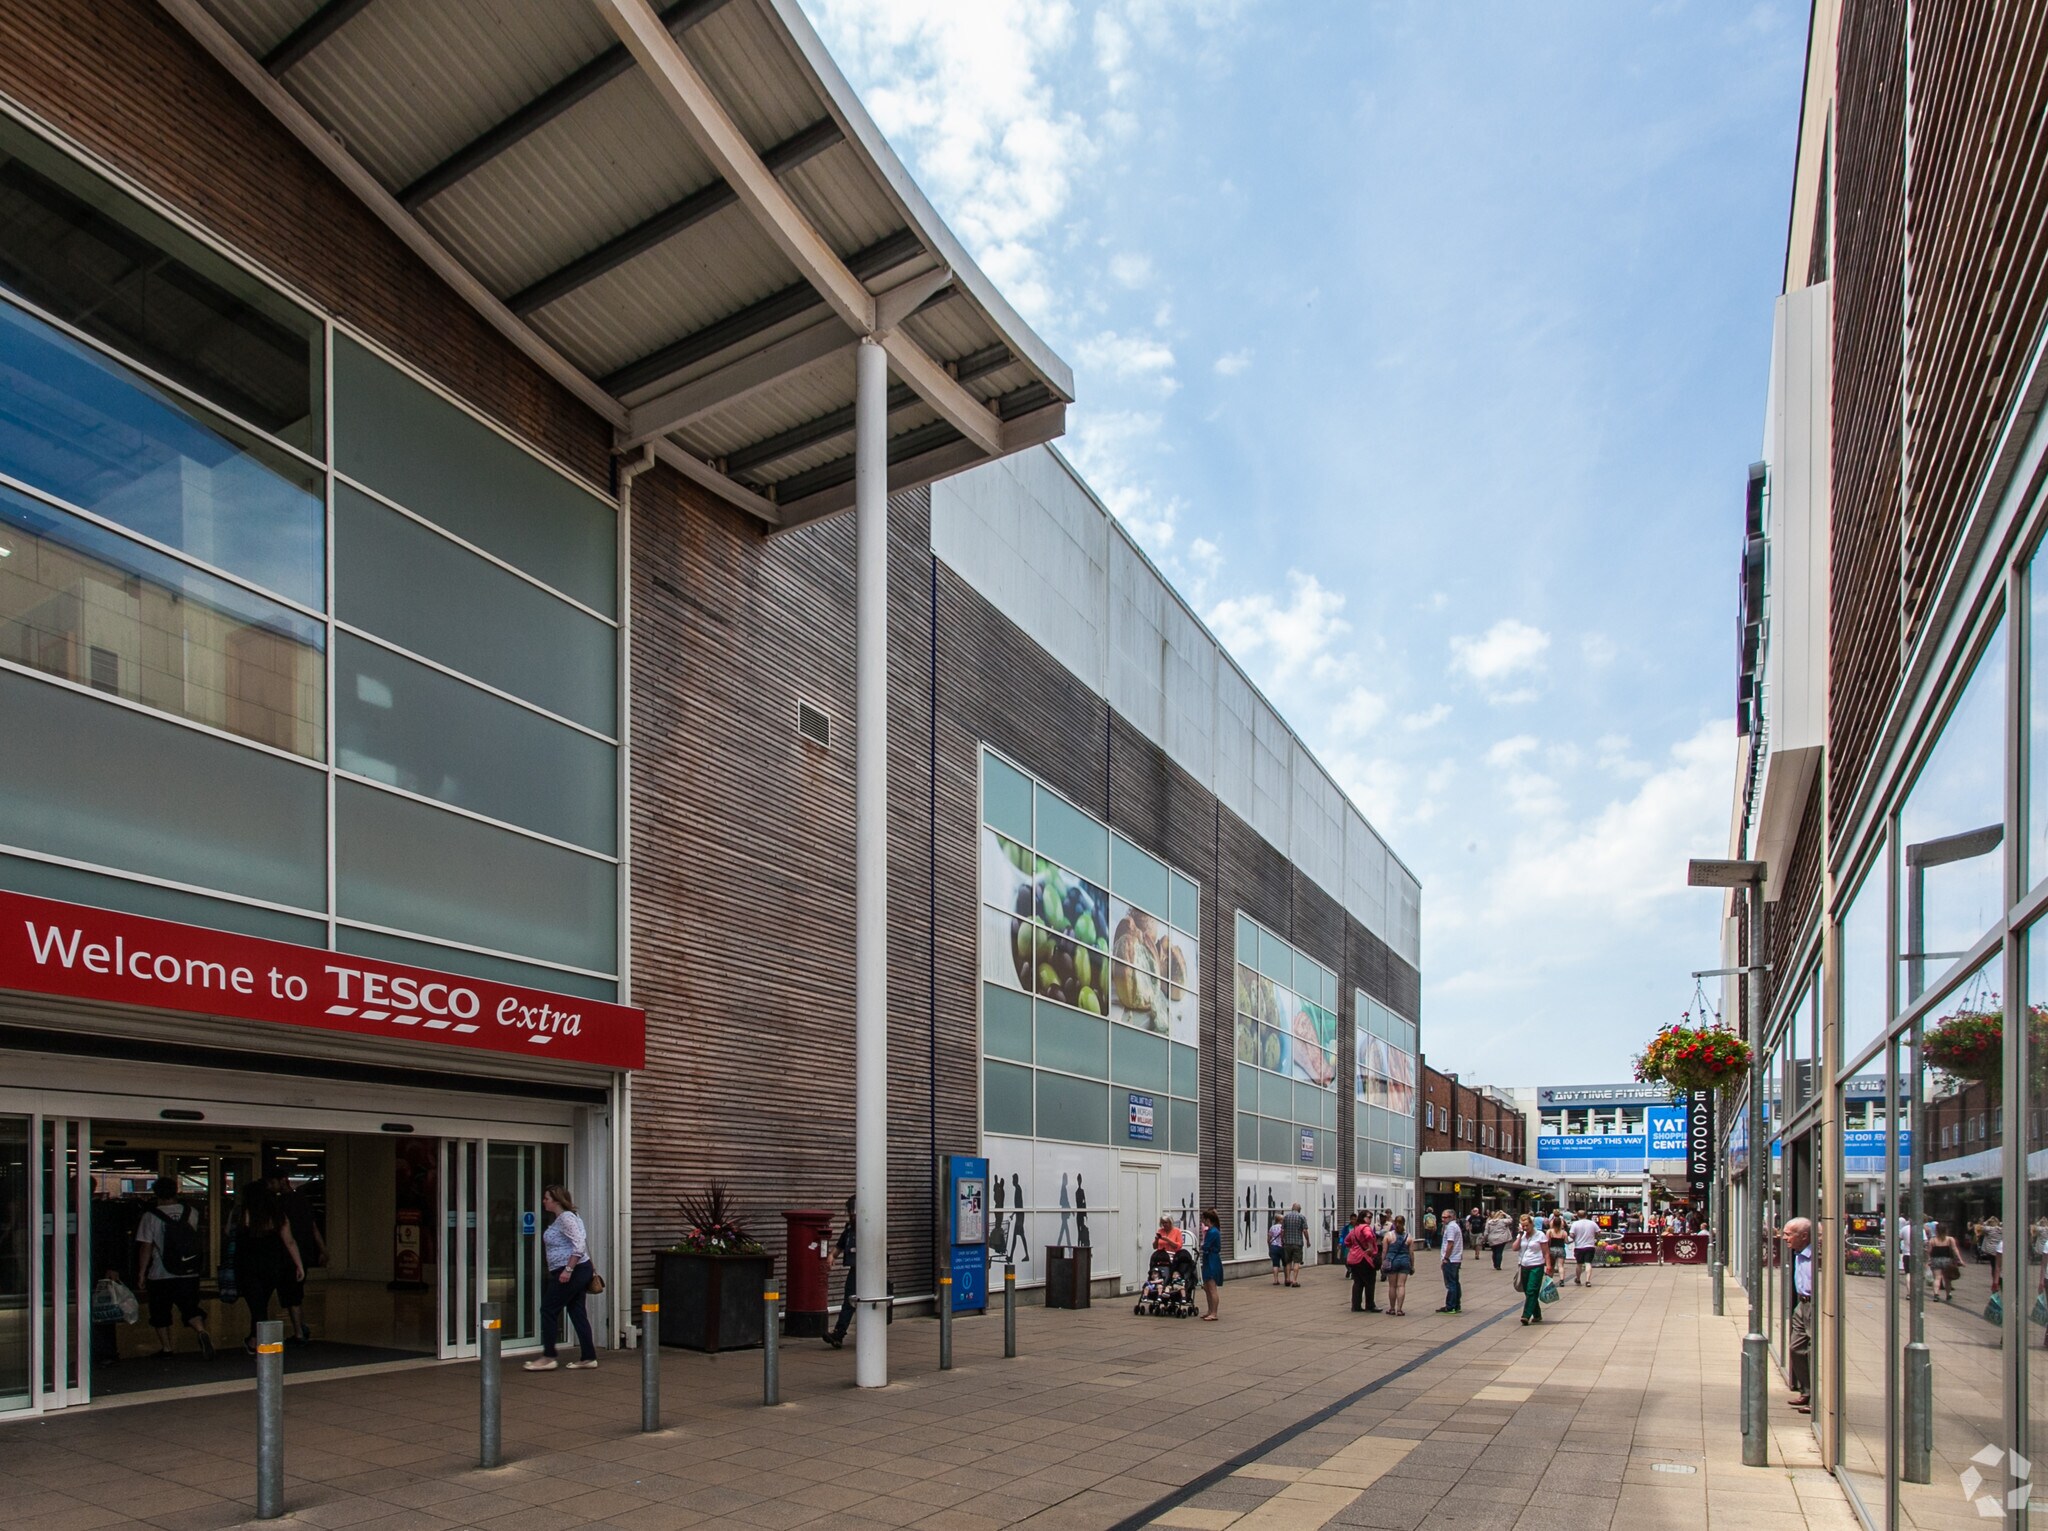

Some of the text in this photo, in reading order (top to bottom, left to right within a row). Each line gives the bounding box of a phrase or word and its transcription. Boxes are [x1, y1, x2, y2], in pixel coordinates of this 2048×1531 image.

[25, 921, 581, 1037] Welcome to TESCO extra
[1555, 1088, 1671, 1100] ANYTIME FITNESS
[1653, 1118, 1685, 1132] YAT
[1653, 1132, 1687, 1140] SHOPPI
[1693, 1091, 1708, 1174] EACOCKS
[1576, 1137, 1602, 1145] SHOPS
[1653, 1140, 1687, 1149] CENTR
